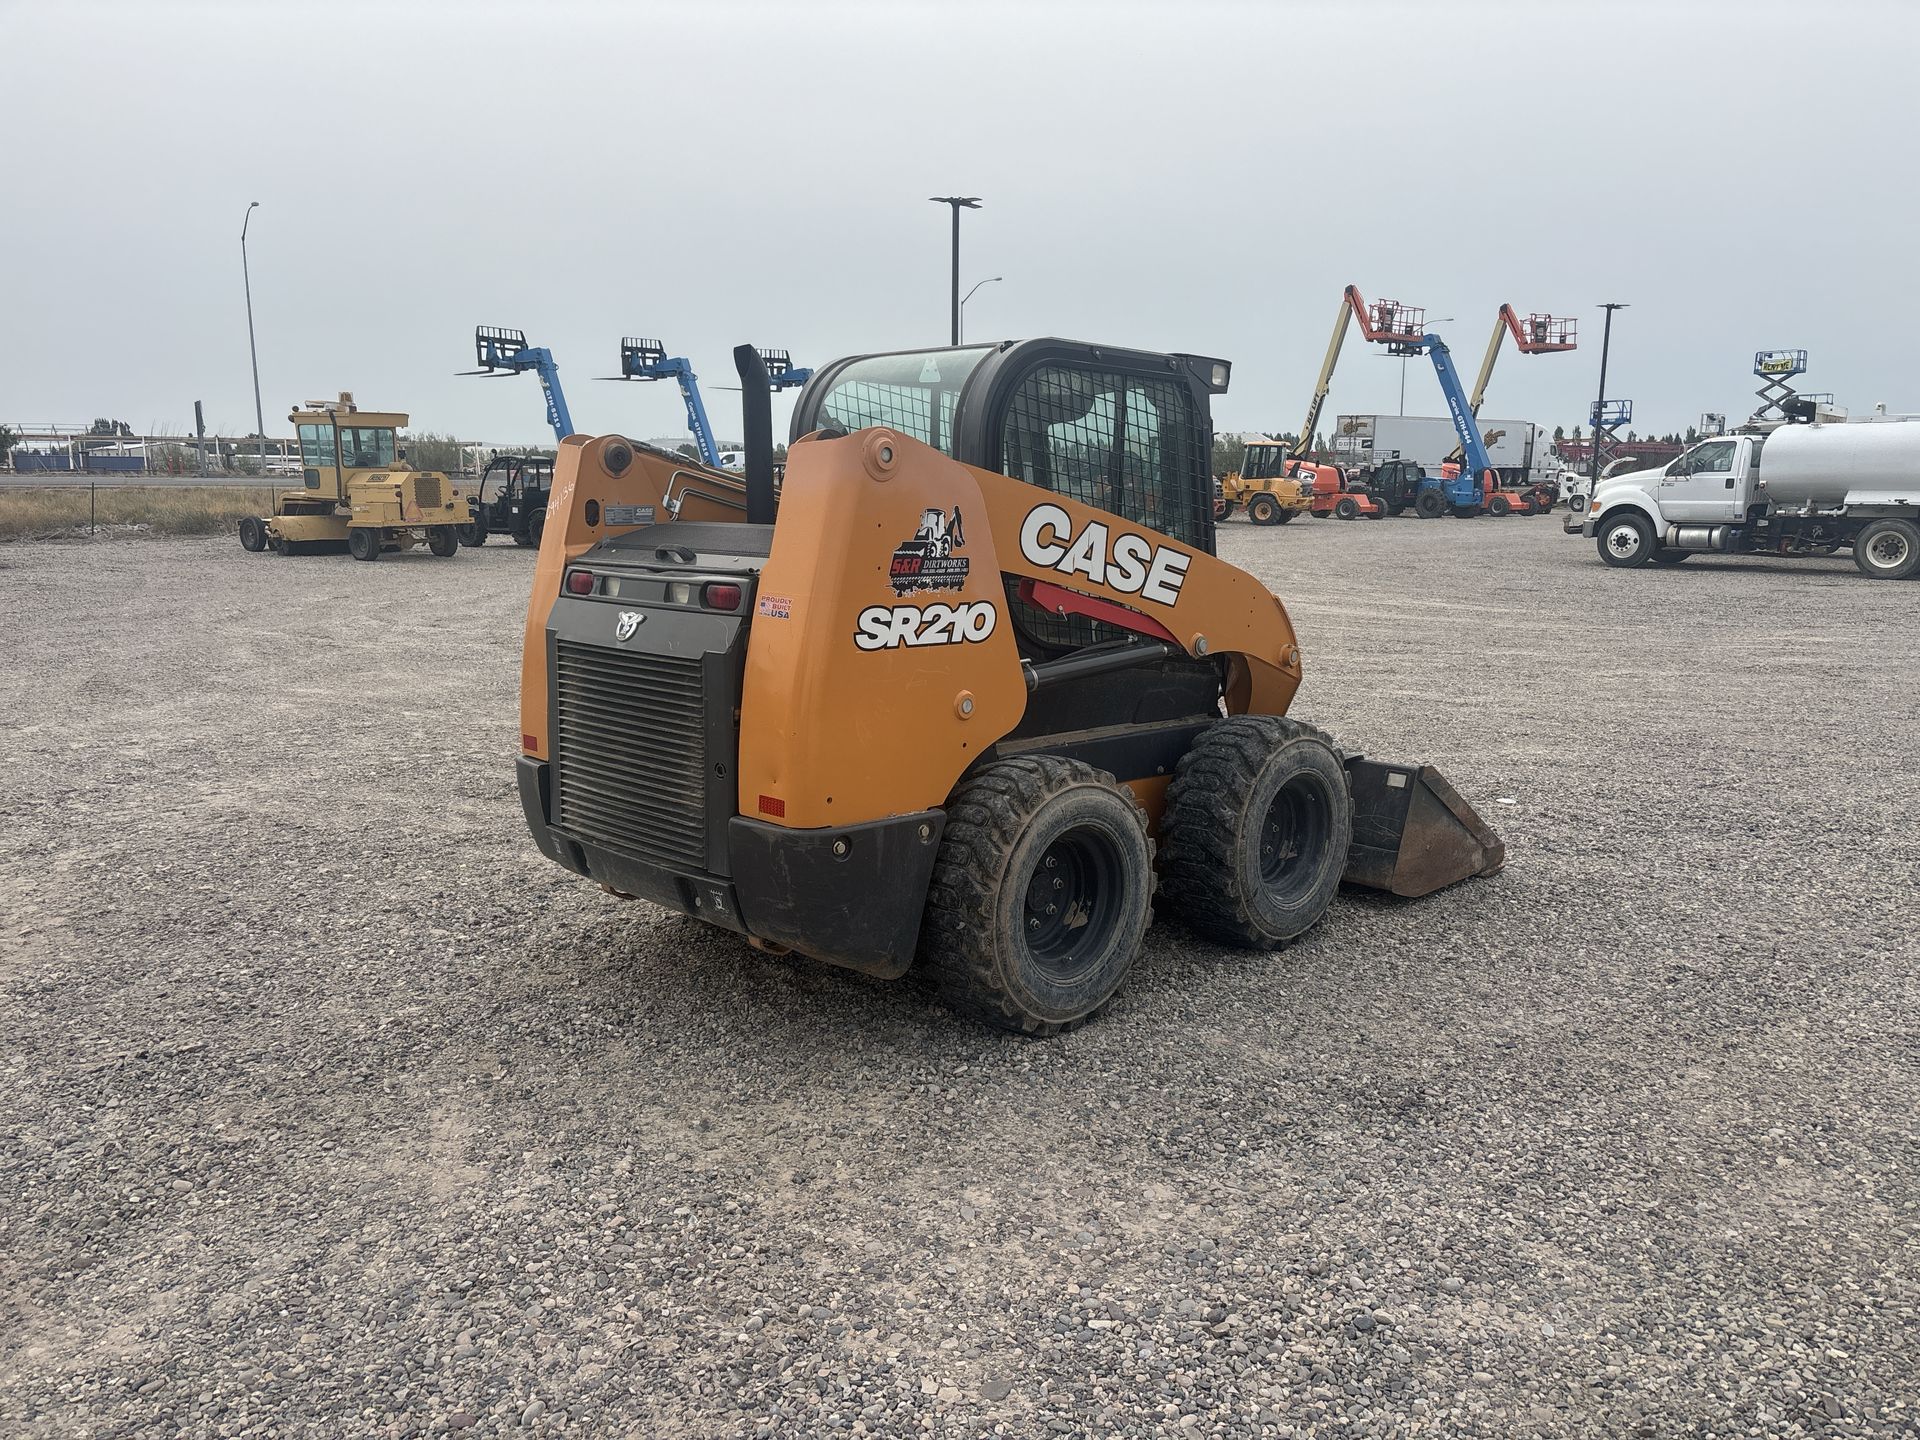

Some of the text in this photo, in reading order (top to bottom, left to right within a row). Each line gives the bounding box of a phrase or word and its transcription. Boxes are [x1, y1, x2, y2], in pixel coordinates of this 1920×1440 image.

[545, 390, 561, 428] GTH-5519
[688, 401, 698, 421] Genie
[1306, 392, 1320, 426] JLG LIFT
[1450, 396, 1472, 444] Genie GTH-844
[890, 558, 921, 573] S&R
[923, 559, 967, 569] DIRTWORKS
[1020, 503, 1191, 607] CASE
[761, 595, 793, 605] PROUDLY
[772, 603, 791, 611] BUILT
[770, 609, 789, 619] USA
[853, 601, 997, 651] SR210
